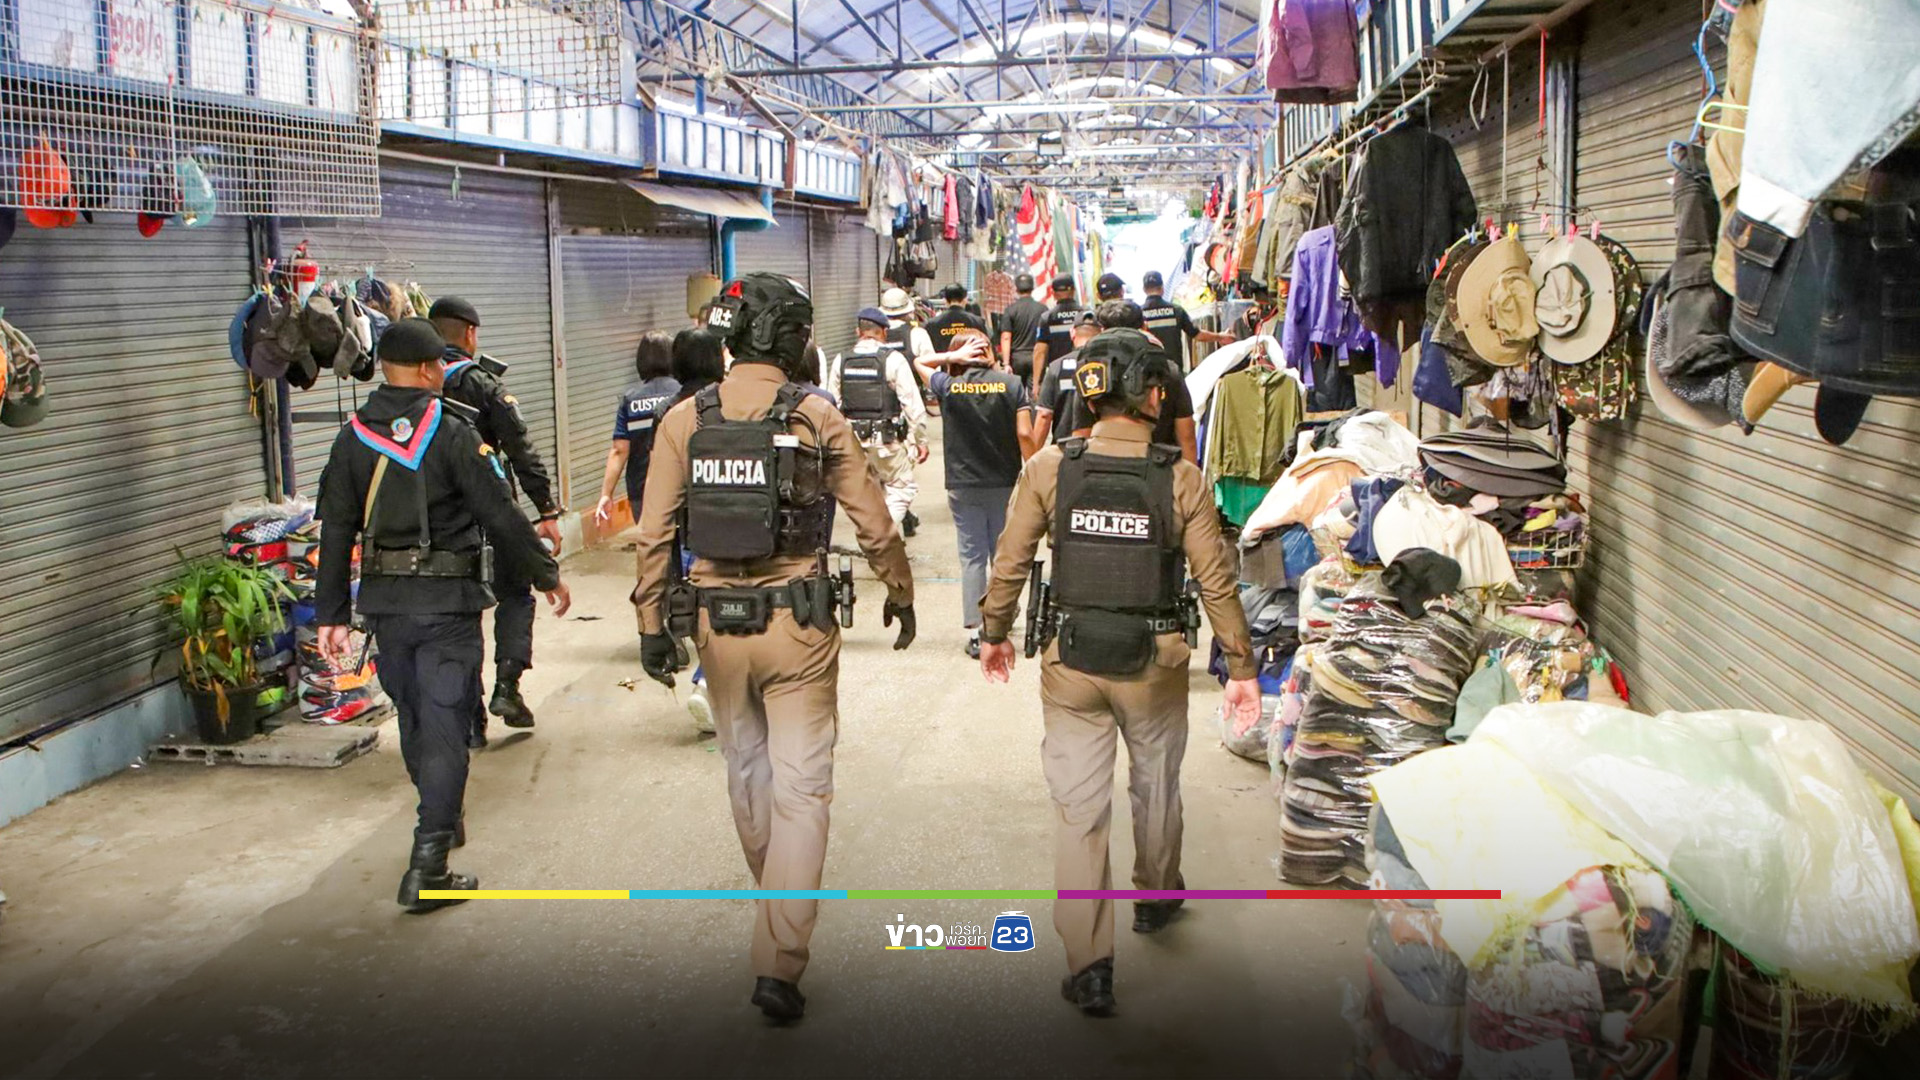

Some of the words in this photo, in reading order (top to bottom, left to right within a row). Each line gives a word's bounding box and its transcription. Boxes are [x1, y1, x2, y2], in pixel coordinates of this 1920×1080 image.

[1057, 310, 1079, 319] POLIC
[951, 382, 1006, 394] CUSTOMS
[692, 459, 766, 485] POLICIA
[1071, 512, 1149, 535] POLICE
